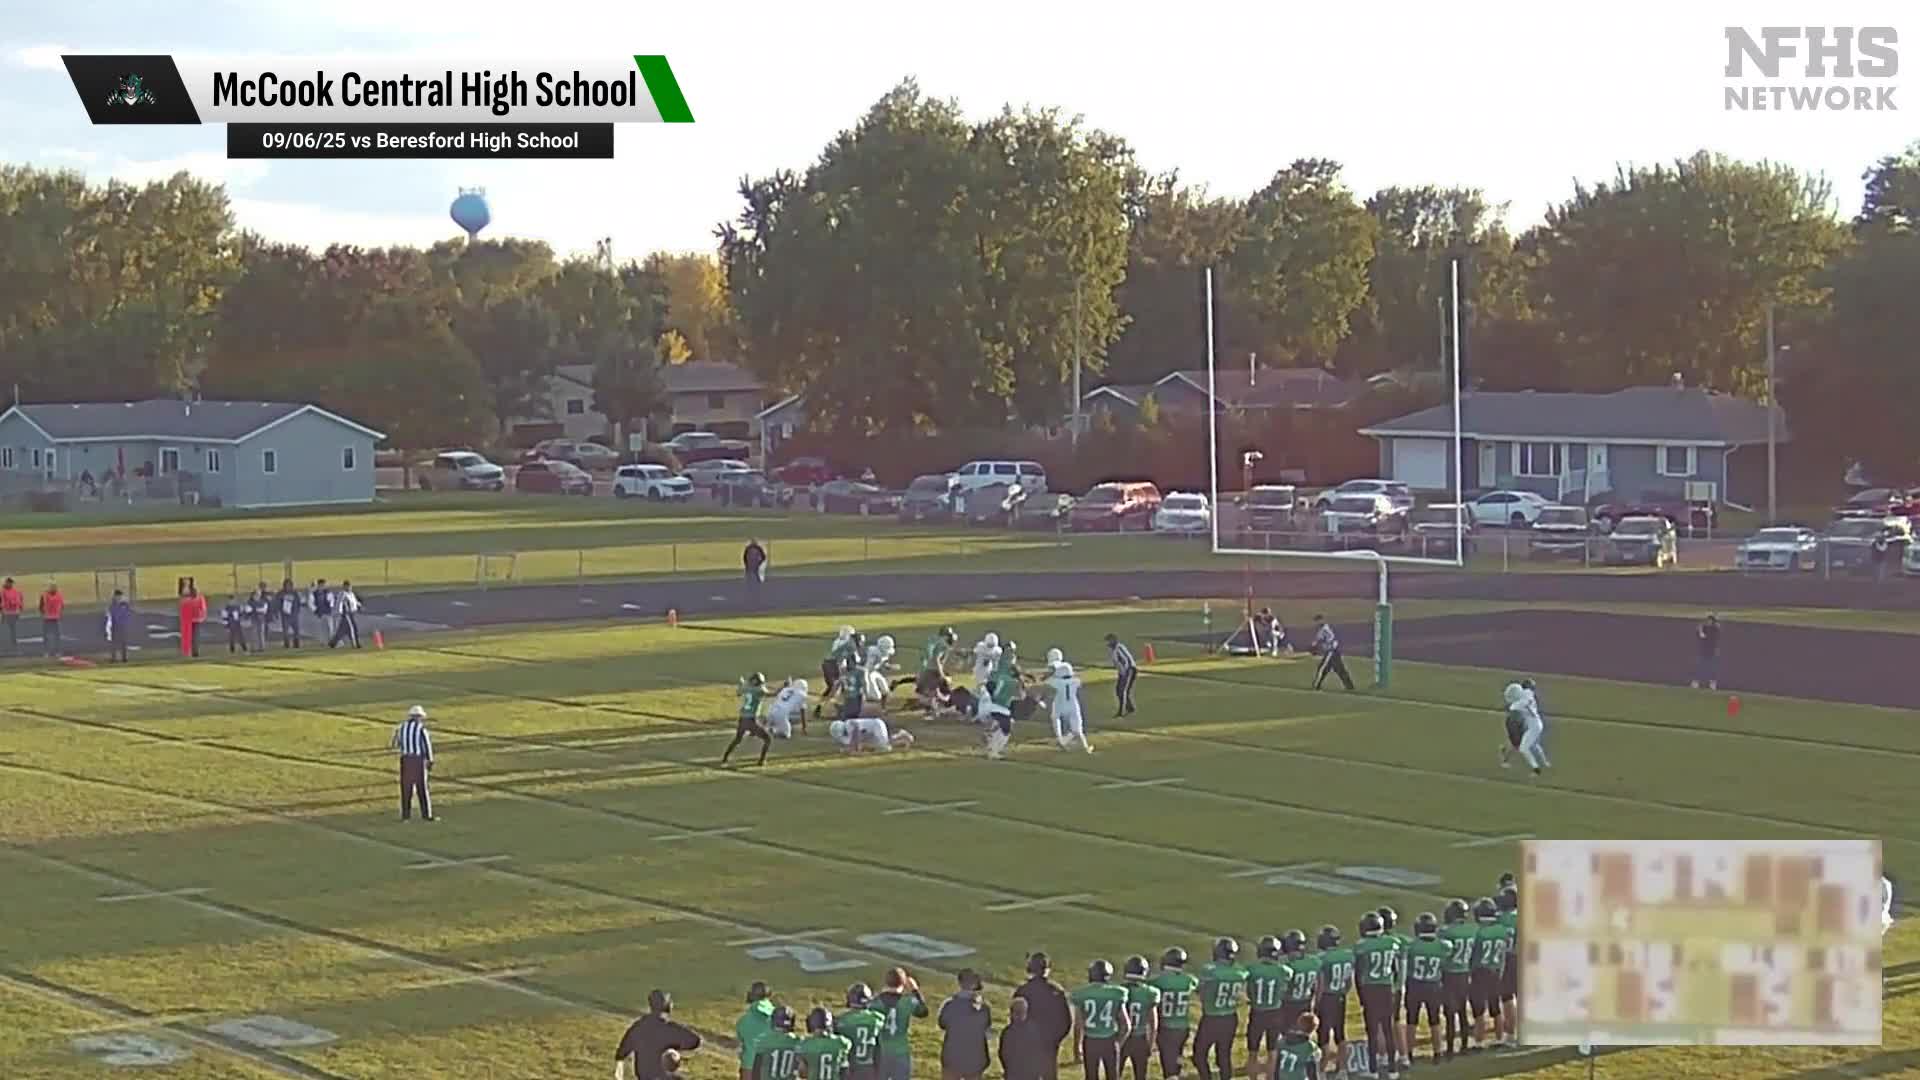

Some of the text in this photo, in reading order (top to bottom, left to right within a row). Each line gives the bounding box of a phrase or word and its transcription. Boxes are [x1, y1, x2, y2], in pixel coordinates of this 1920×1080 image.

[1413, 956, 1440, 980] 53
[1161, 991, 1188, 1017] 65
[1255, 977, 1277, 1005] 11
[1084, 999, 1113, 1028] 24
[770, 1049, 794, 1078] 10
